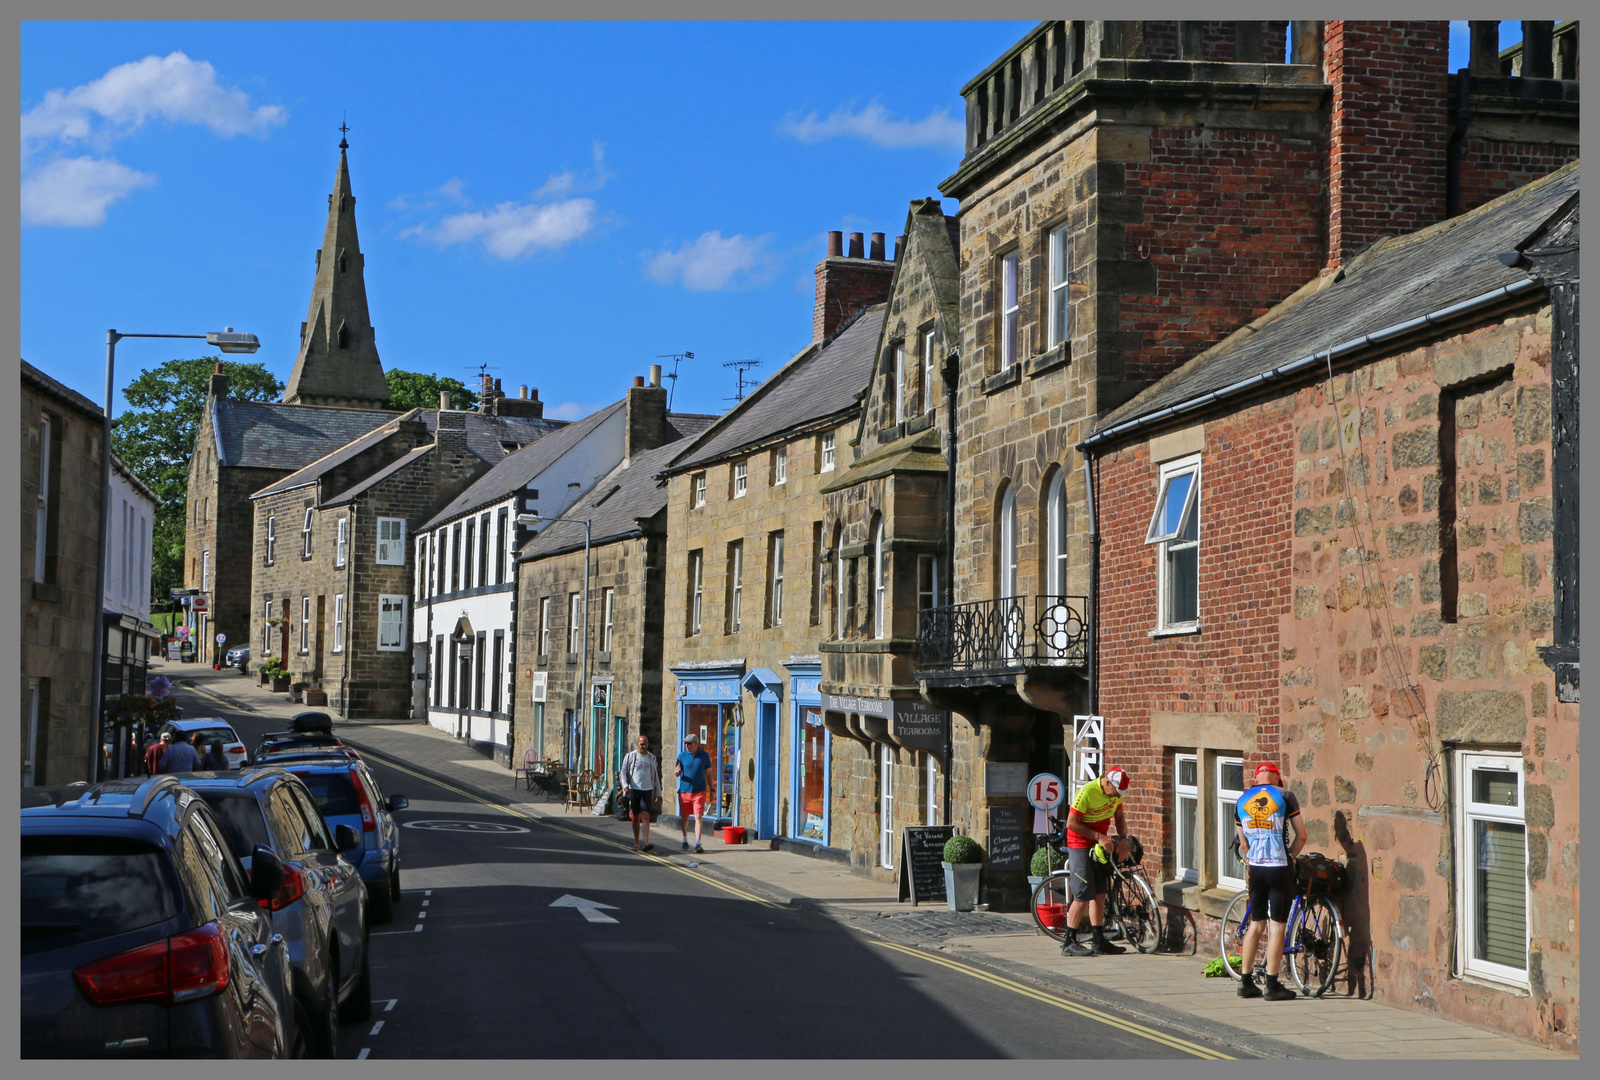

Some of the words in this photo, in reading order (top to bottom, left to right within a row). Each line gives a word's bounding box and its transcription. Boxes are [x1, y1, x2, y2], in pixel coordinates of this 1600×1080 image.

[688, 682, 697, 694] The
[707, 682, 717, 694] Gift
[719, 682, 731, 696] Shop
[829, 696, 839, 709] THE
[839, 696, 857, 711] VILLAGE
[858, 699, 883, 713] TEAROOMS
[912, 702, 926, 711] THE
[897, 712, 941, 723] VILLAGE
[897, 726, 940, 736] TEAROOMS
[1033, 781, 1059, 802] 15
[922, 840, 945, 848] TEAROOM
[993, 836, 1011, 845] Come
[992, 846, 1000, 855] the
[992, 856, 1011, 864] always
